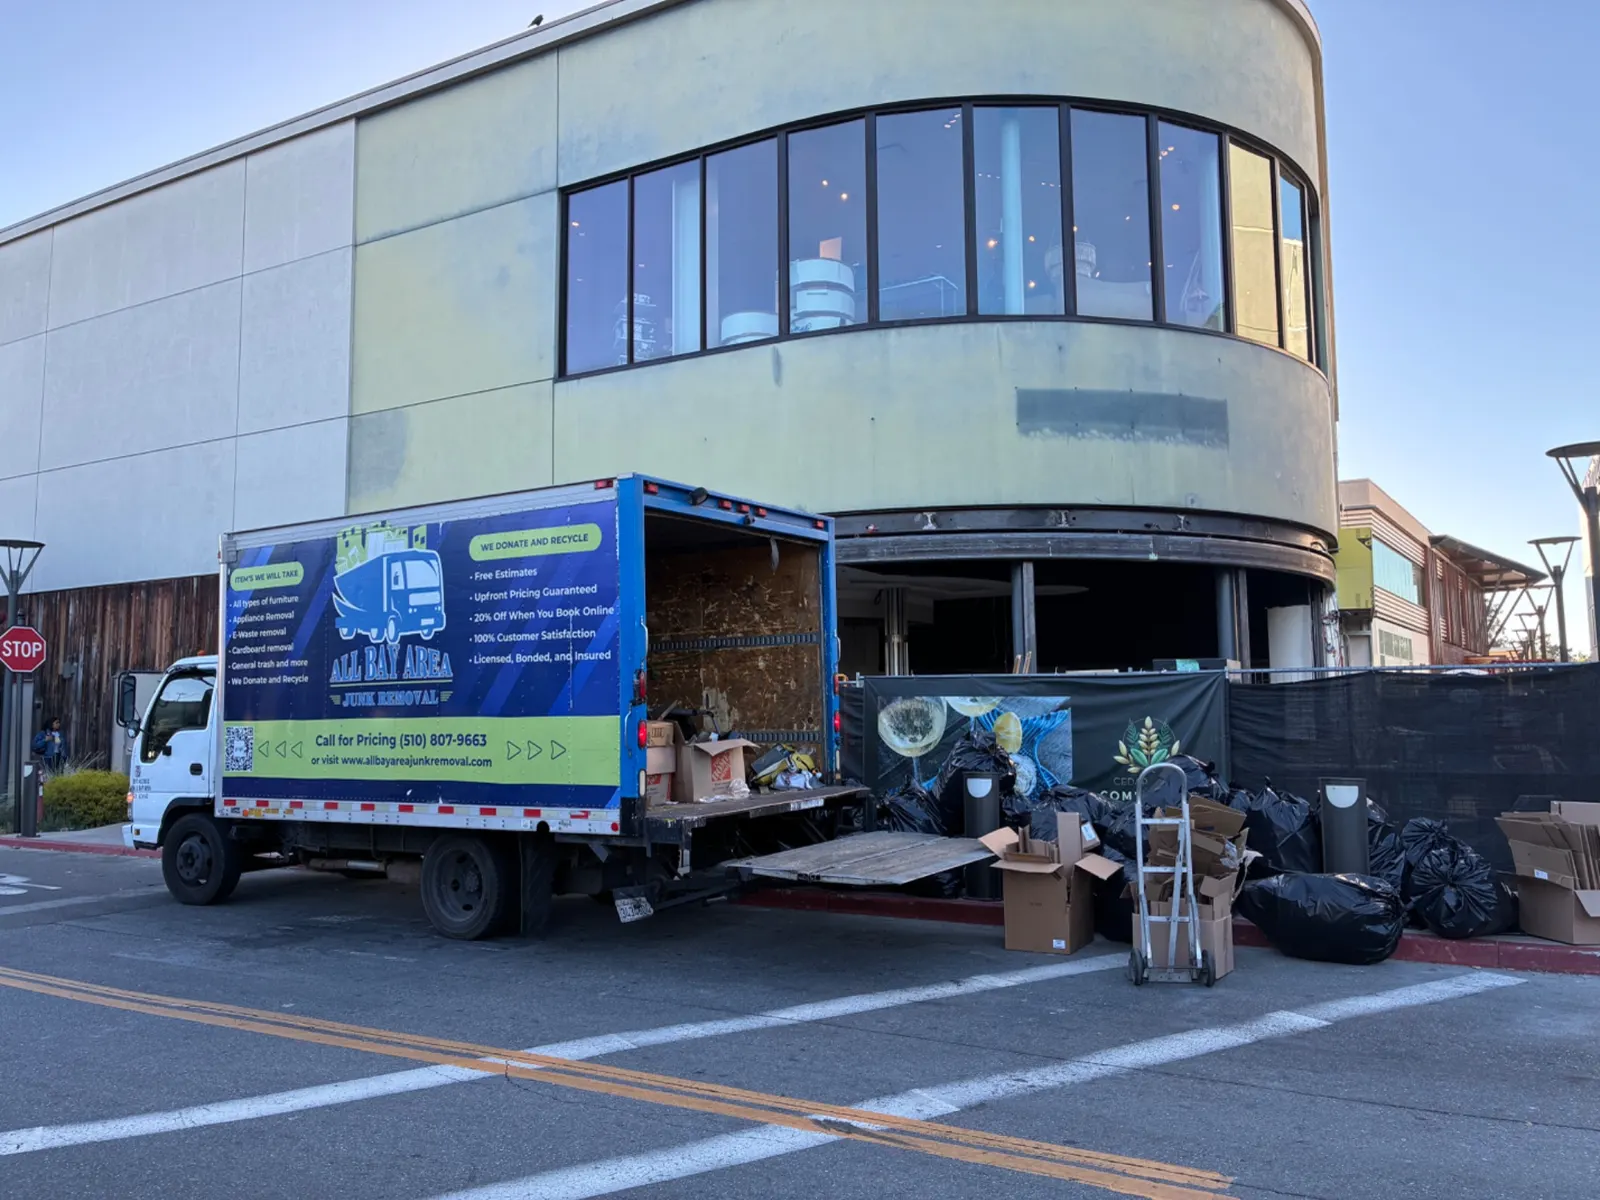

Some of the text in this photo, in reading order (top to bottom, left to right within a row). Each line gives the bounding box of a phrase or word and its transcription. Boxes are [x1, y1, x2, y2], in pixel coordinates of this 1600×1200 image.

[481, 534, 588, 551] WE DONATE AND RECYCLE
[282, 569, 298, 578] TAKE
[474, 568, 537, 580] Free Estimates
[474, 584, 597, 603] Upfront Pricing Guaranteed
[233, 595, 298, 609] All types of furniture
[233, 611, 294, 624] Appliance Removal
[474, 605, 614, 622] 20% Off When You Book Online
[232, 627, 286, 639] E-Waste removal
[474, 628, 596, 643] 100% Customer Satisfaction
[2, 640, 42, 658] STOP
[232, 643, 294, 654] Cardboard removal
[329, 644, 453, 683] ALL BAY AREA
[474, 650, 611, 664] Licensed, Bonded, and Insured
[232, 661, 256, 670] General
[258, 660, 274, 668] trash
[276, 659, 288, 667] and
[243, 677, 267, 685] Donate
[268, 676, 281, 684] and
[283, 674, 308, 685] Recycle
[342, 689, 438, 707] JUNK REMOVAL
[316, 732, 487, 749] Call for Pricing (510) 807-9663
[322, 755, 339, 765] visit
[341, 755, 492, 768] www.allbayareajunkremoval.com
